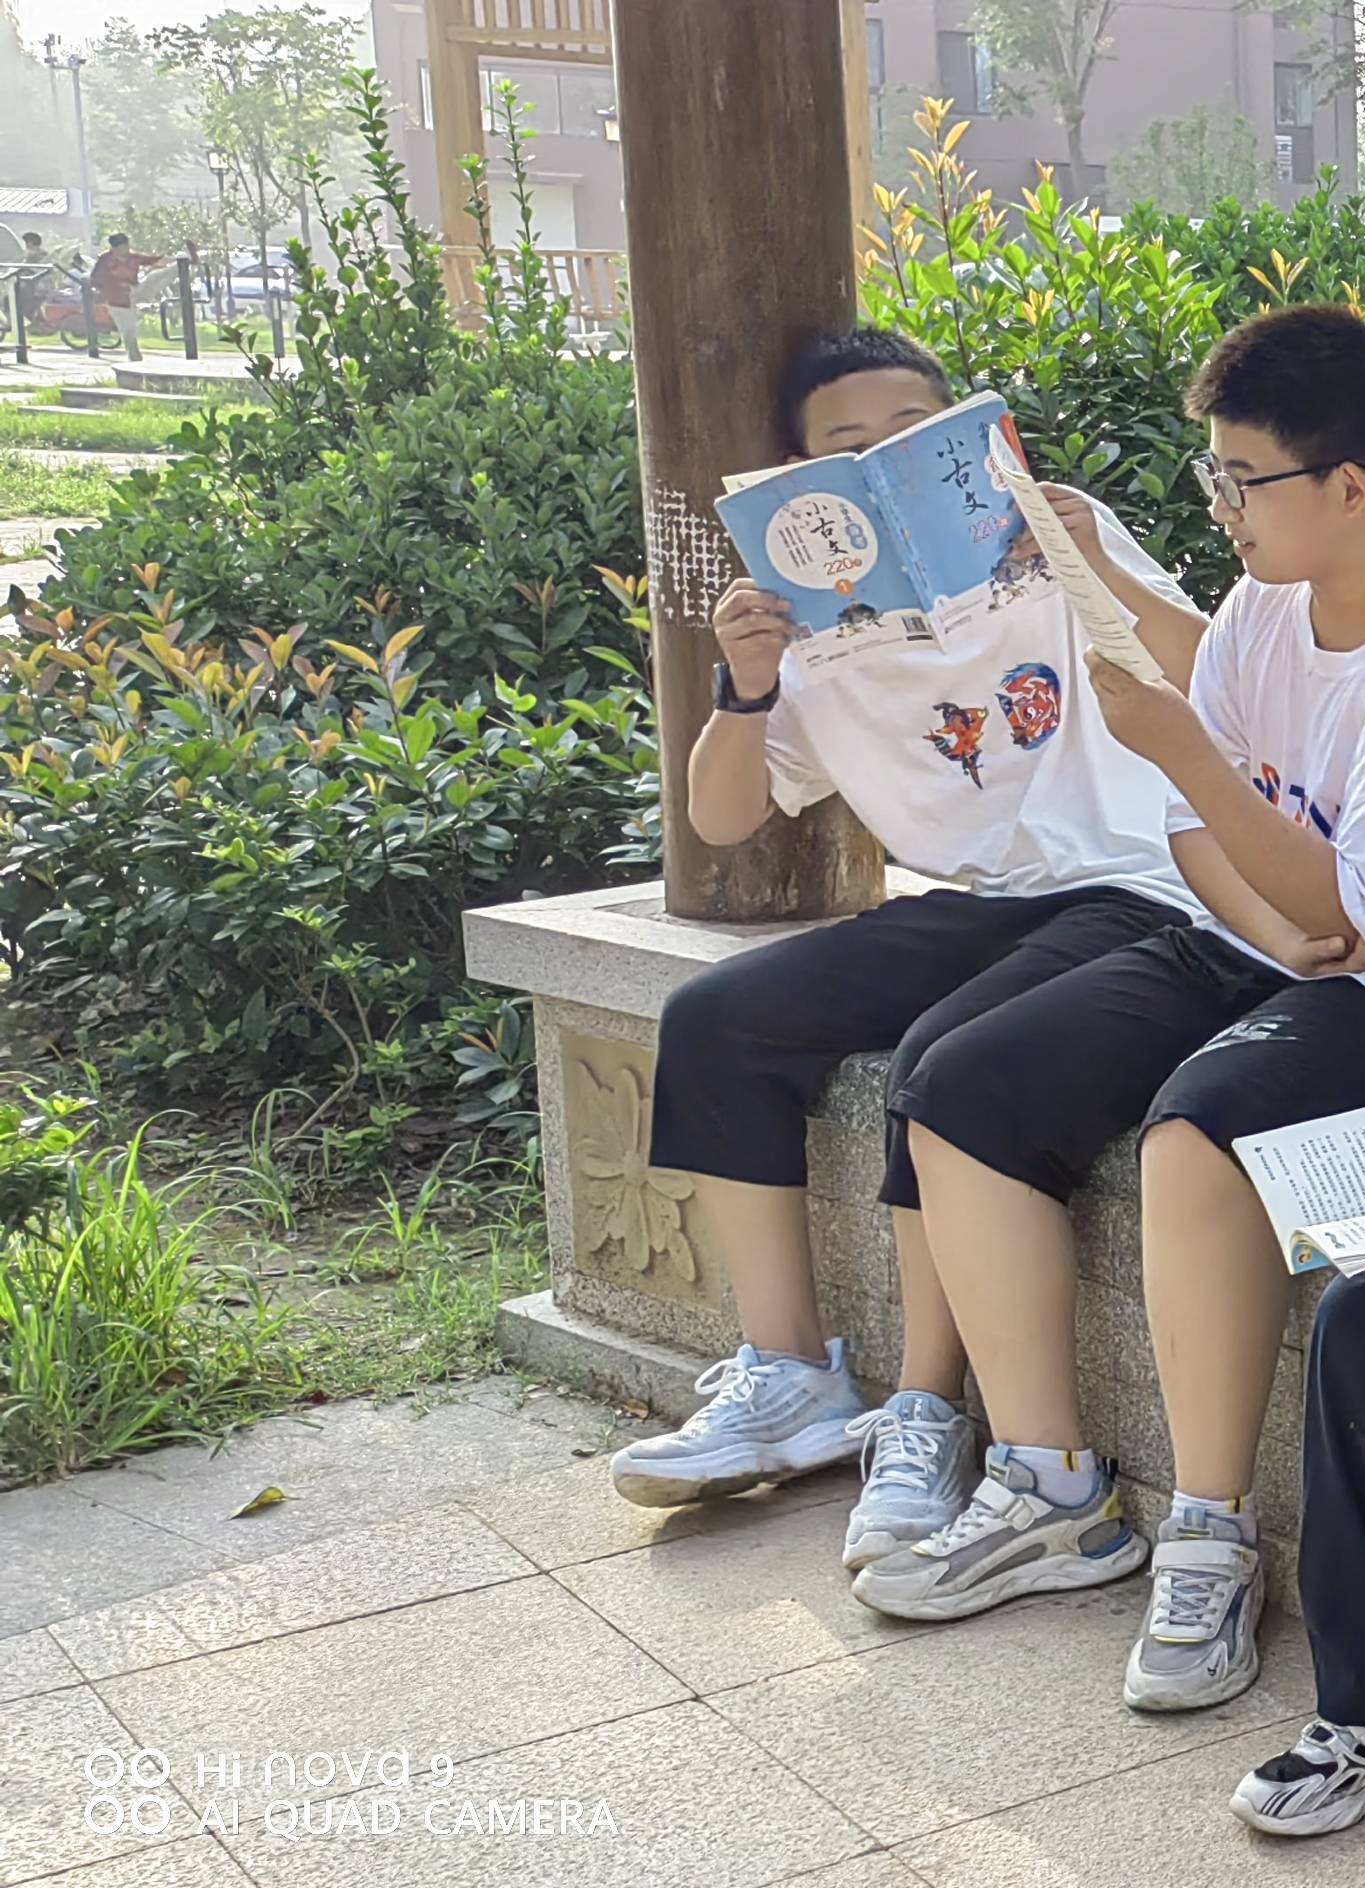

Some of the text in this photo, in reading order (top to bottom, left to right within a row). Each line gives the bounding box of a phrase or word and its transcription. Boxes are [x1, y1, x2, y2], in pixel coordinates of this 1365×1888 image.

[937, 437, 989, 515] 小古文
[806, 502, 848, 556] 小古文
